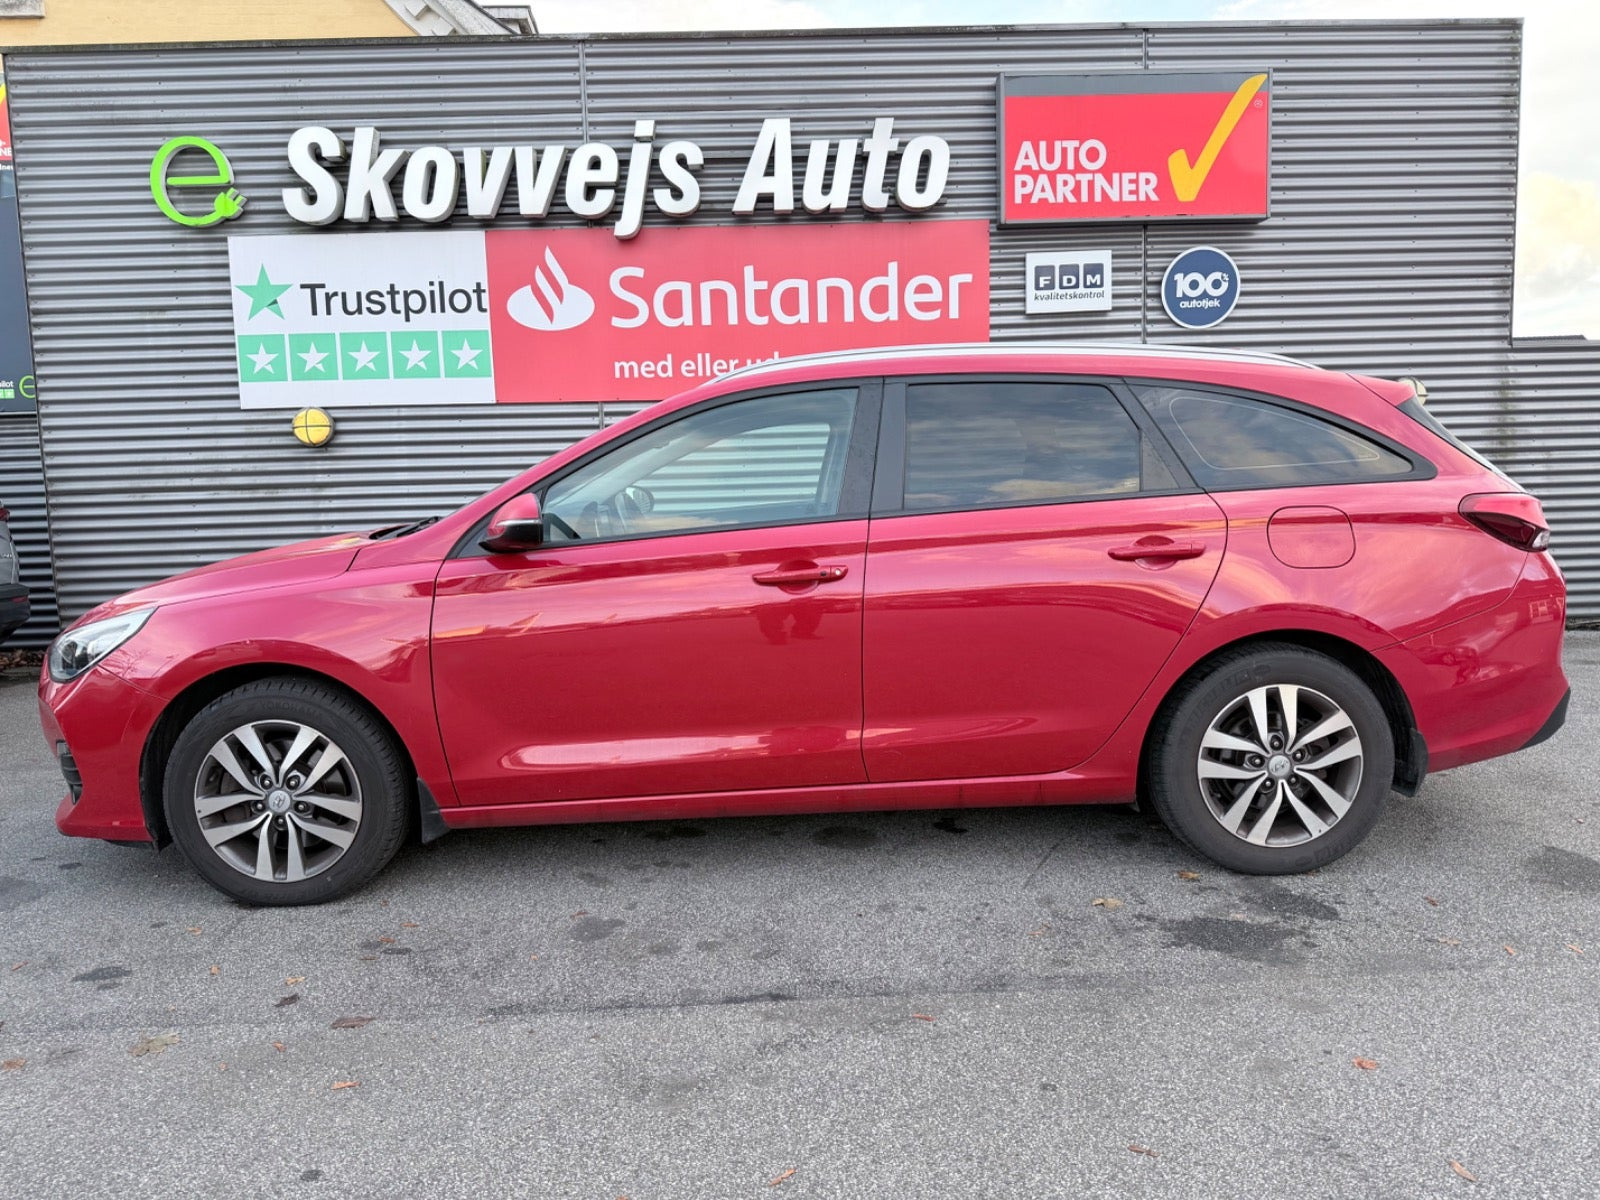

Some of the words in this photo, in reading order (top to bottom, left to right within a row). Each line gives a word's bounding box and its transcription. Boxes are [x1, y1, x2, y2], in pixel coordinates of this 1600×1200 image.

[1014, 139, 1107, 171] AUTO
[282, 120, 704, 240] Skovvejs
[732, 118, 951, 214] Auto
[1014, 172, 1159, 204] PARTNER
[299, 280, 488, 322] Trustpilot
[609, 261, 973, 328] Santander
[1034, 290, 1105, 301] kvalitetskontrol
[1179, 298, 1221, 309] autotjek
[614, 353, 673, 378] med
[680, 353, 739, 377] eller
